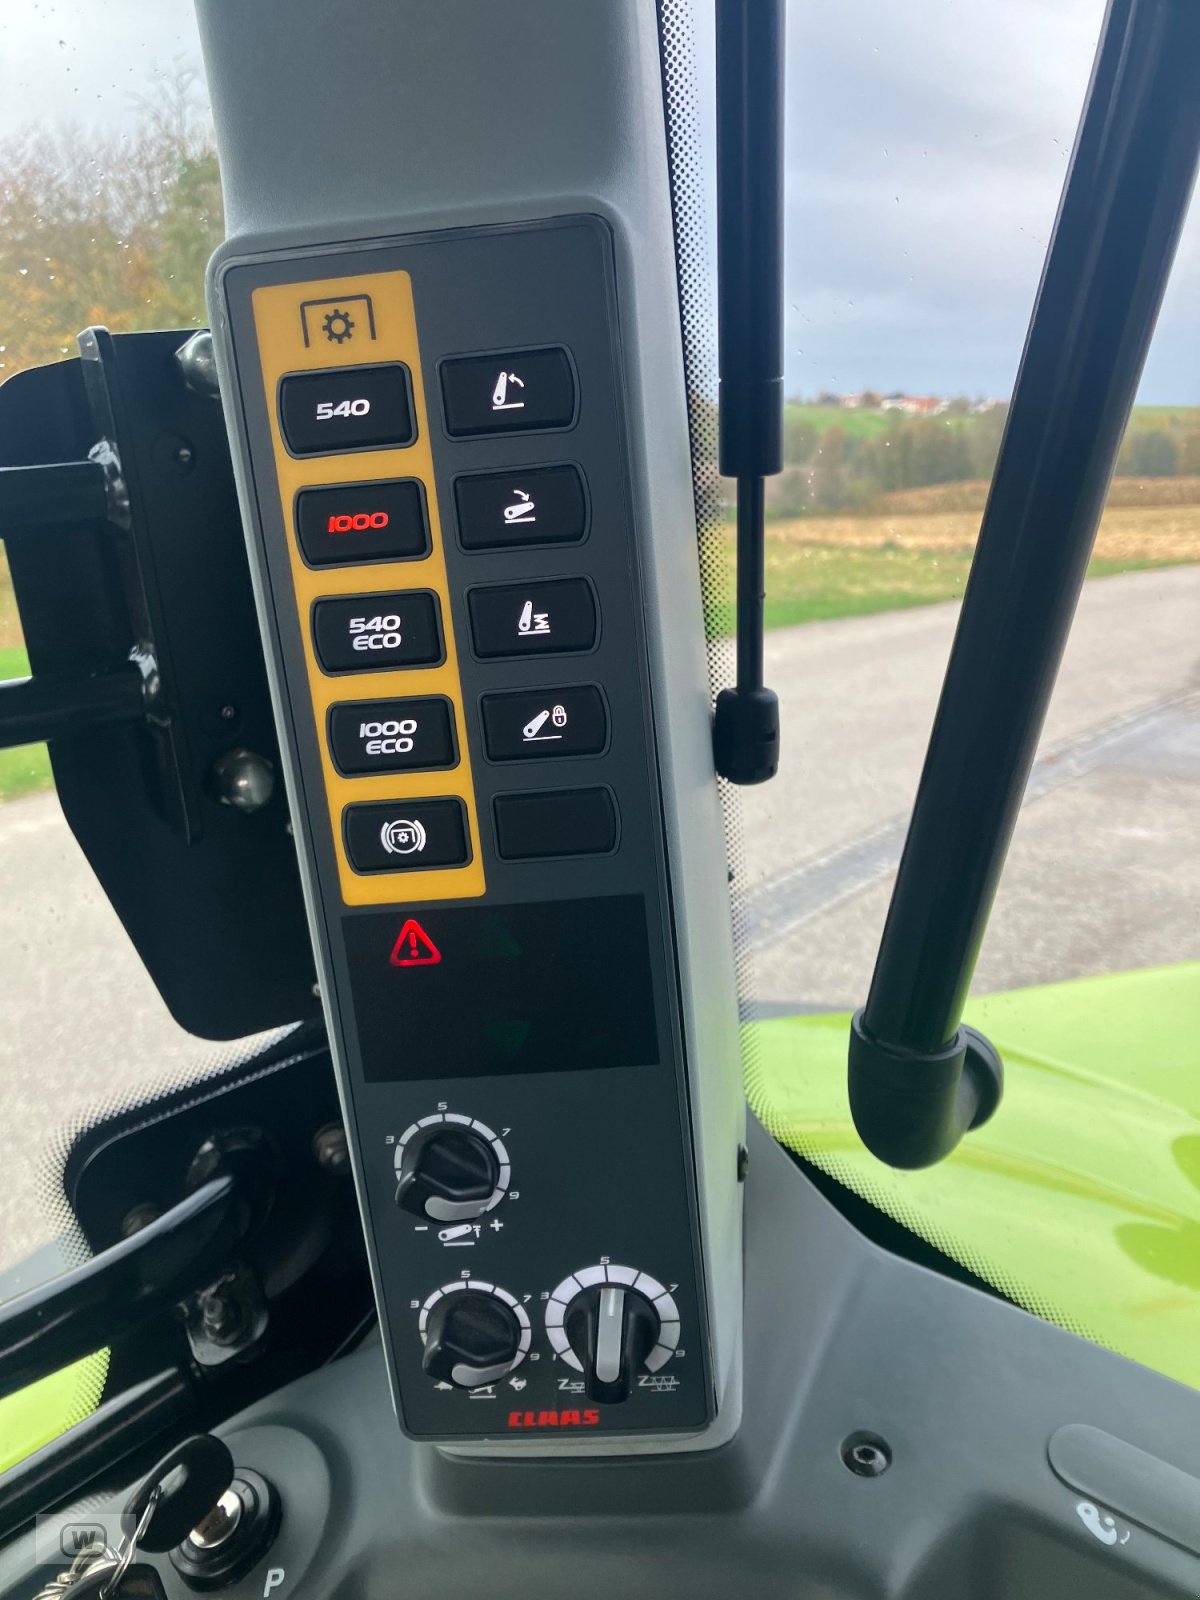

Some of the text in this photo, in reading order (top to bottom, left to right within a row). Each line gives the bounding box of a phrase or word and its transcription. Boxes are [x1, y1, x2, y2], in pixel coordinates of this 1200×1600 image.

[316, 399, 370, 420] 540
[328, 512, 389, 533] 1000
[349, 615, 401, 634] 540
[352, 632, 402, 650] ECO
[359, 719, 417, 738] 1000
[365, 737, 414, 755] ECO
[437, 1102, 448, 1110] 5
[502, 1128, 511, 1136] 7
[385, 1136, 395, 1144] 3
[509, 1191, 520, 1200] 9
[600, 1256, 610, 1265] 5
[461, 1270, 471, 1278] 5
[669, 1284, 679, 1292] 7
[523, 1295, 532, 1303] 7
[540, 1292, 550, 1300] 3
[410, 1300, 420, 1308] 3
[530, 1353, 540, 1361] 9
[675, 1350, 686, 1358] 9
[508, 1409, 600, 1427] CLAAS
[263, 1568, 285, 1598] P
